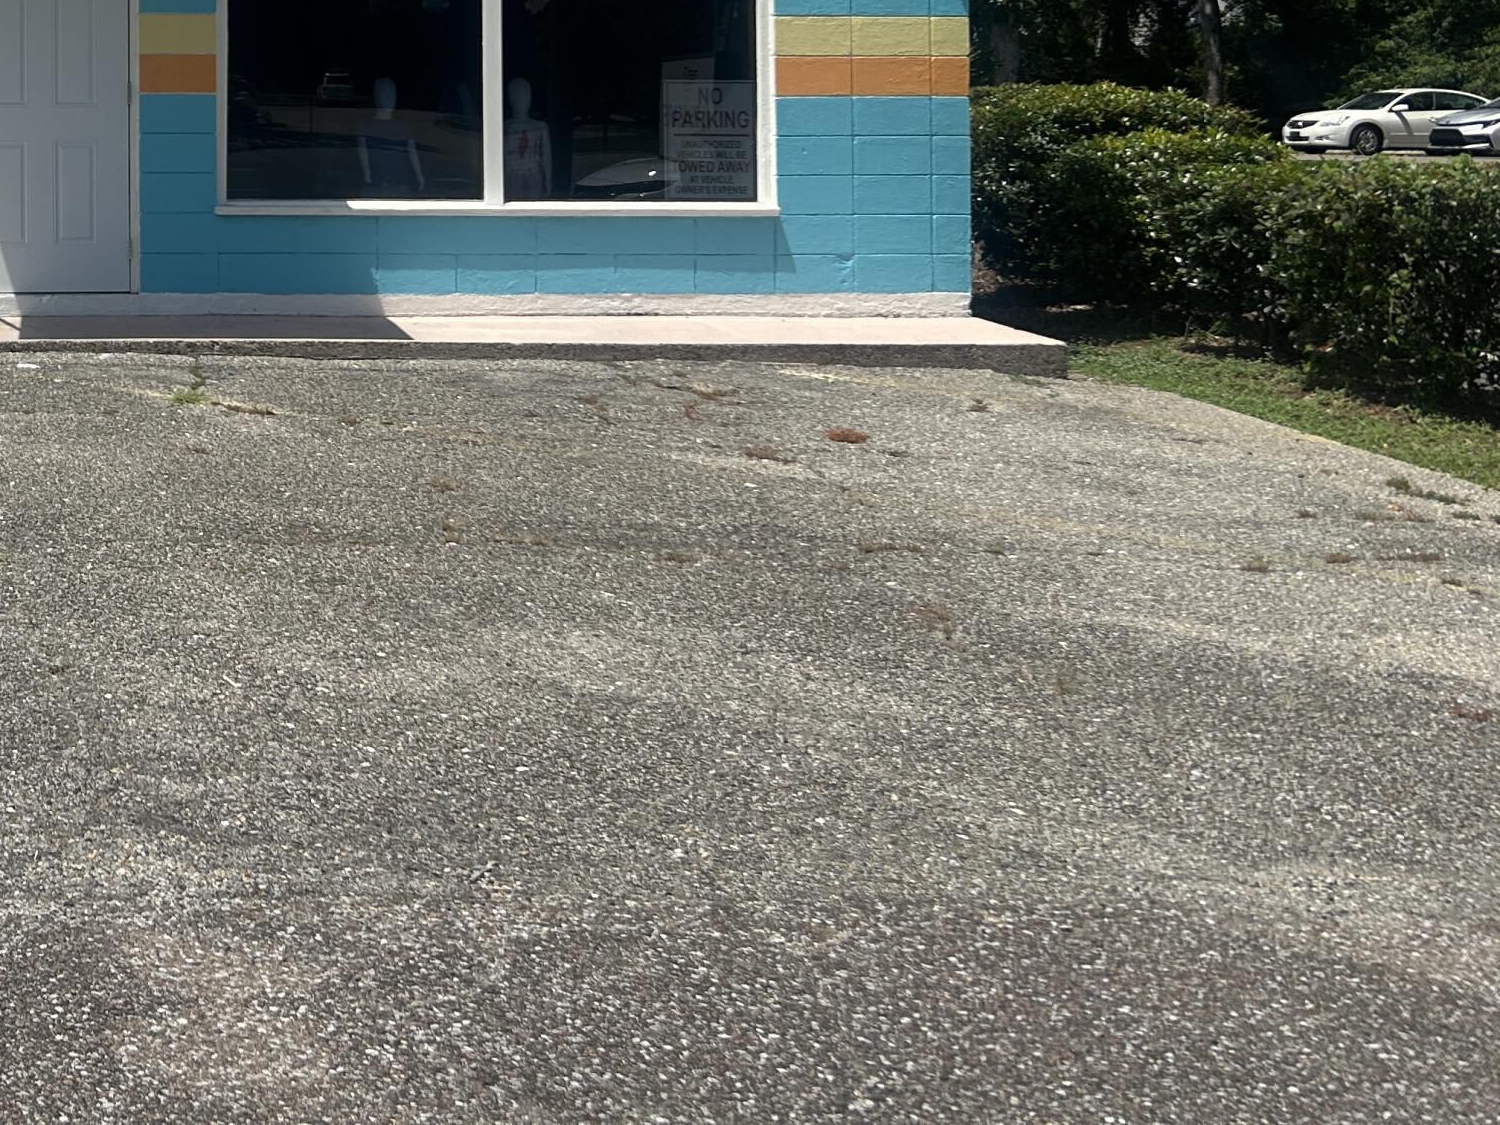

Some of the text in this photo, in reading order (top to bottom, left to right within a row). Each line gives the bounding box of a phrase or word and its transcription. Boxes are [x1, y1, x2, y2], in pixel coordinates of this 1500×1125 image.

[699, 87, 723, 105] NO
[672, 110, 749, 128] PARKING
[717, 160, 750, 173] AWAY
